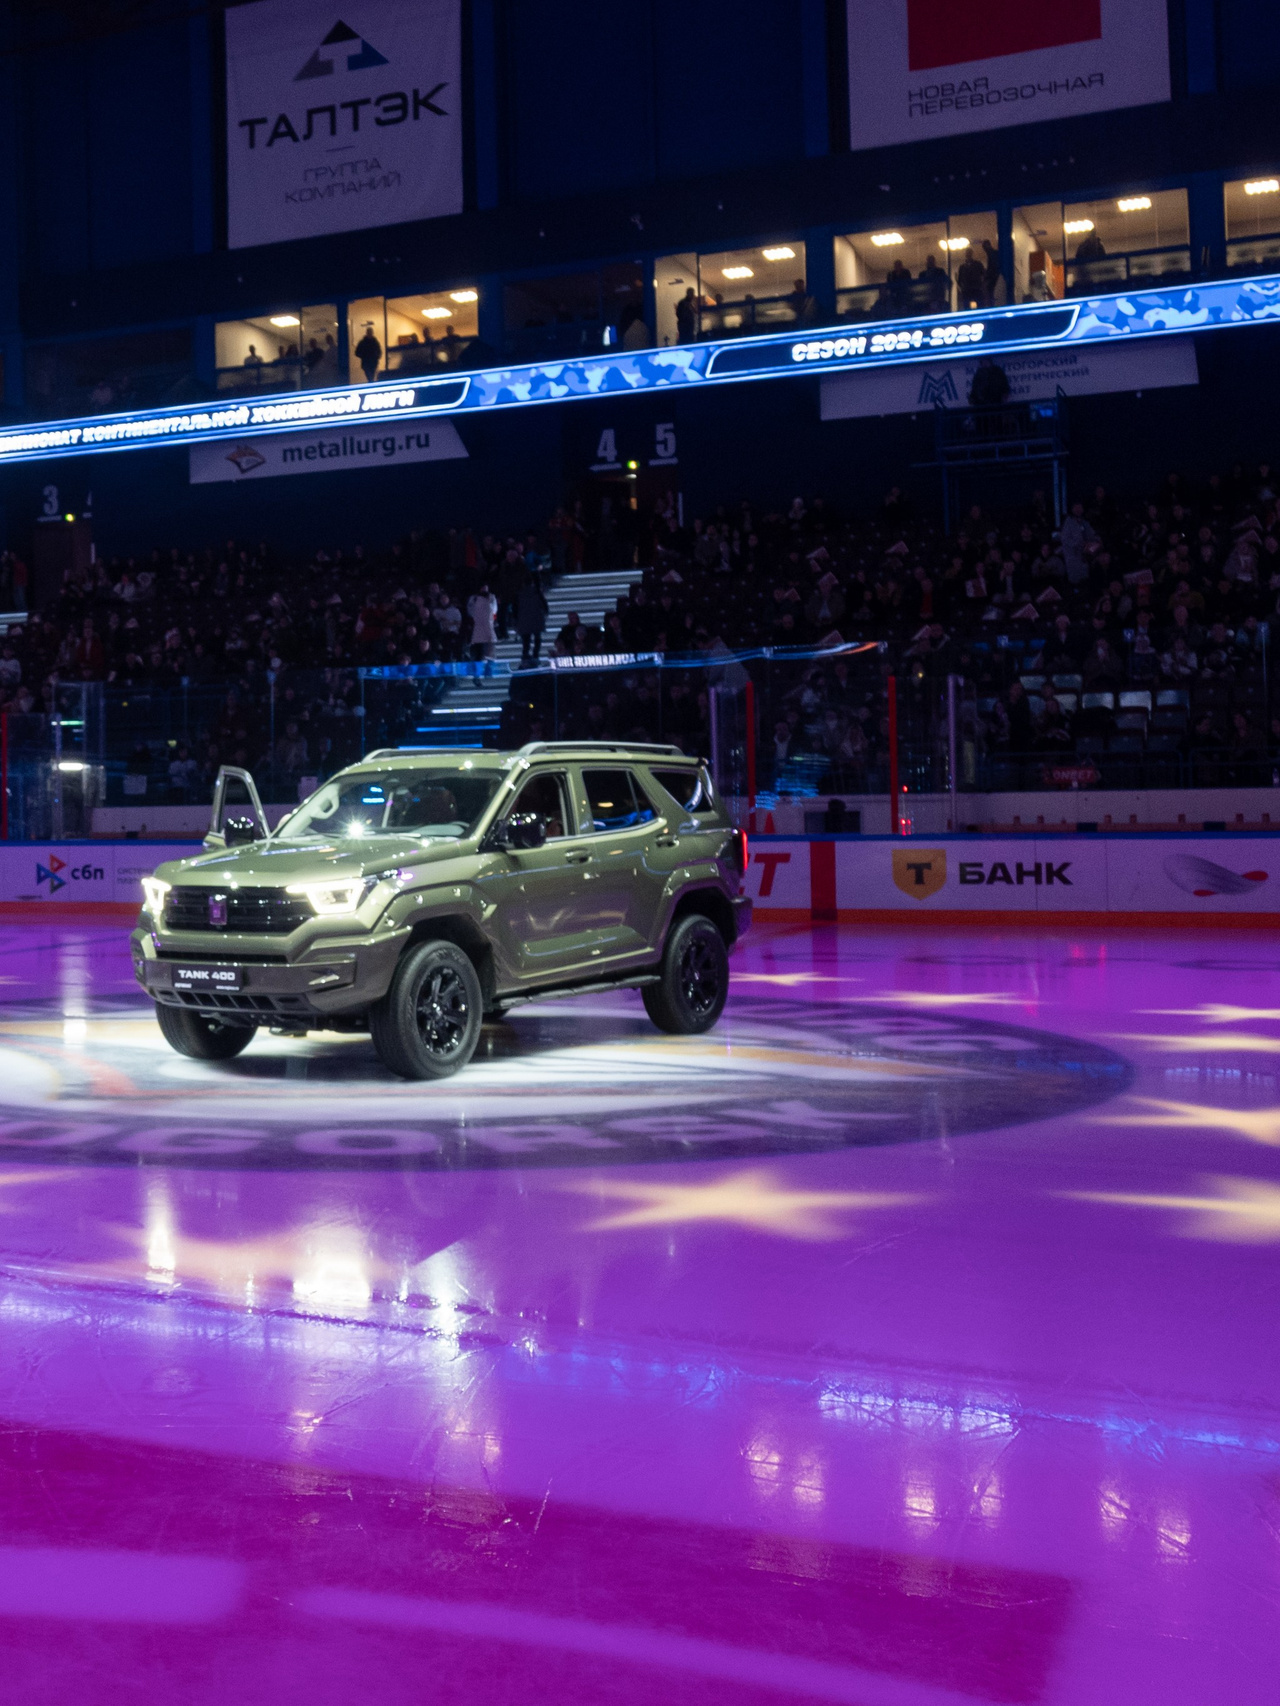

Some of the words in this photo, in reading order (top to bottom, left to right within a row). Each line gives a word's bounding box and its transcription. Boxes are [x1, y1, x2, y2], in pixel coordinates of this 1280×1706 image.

[908, 77, 990, 101] НОВАЯ
[908, 72, 1105, 118] ПЕРЕВОЗОЧНАЯ
[238, 82, 449, 149] ТАЛТЭК
[303, 158, 382, 182] ГРУППА
[284, 171, 402, 203] КОМПАНИЙ
[792, 337, 867, 361] СЕЗОН
[870, 323, 985, 352] 2024-2025
[965, 355, 1078, 375] МТОГОРСКИЙ
[282, 432, 430, 463] metallurg.ru
[596, 428, 618, 462] 4
[655, 422, 677, 458] 5
[42, 484, 60, 515] 3
[71, 863, 104, 880] сбп
[906, 862, 932, 885] Т
[959, 861, 1073, 886] БАНК
[178, 969, 210, 980] TANK
[211, 971, 236, 981] 400
